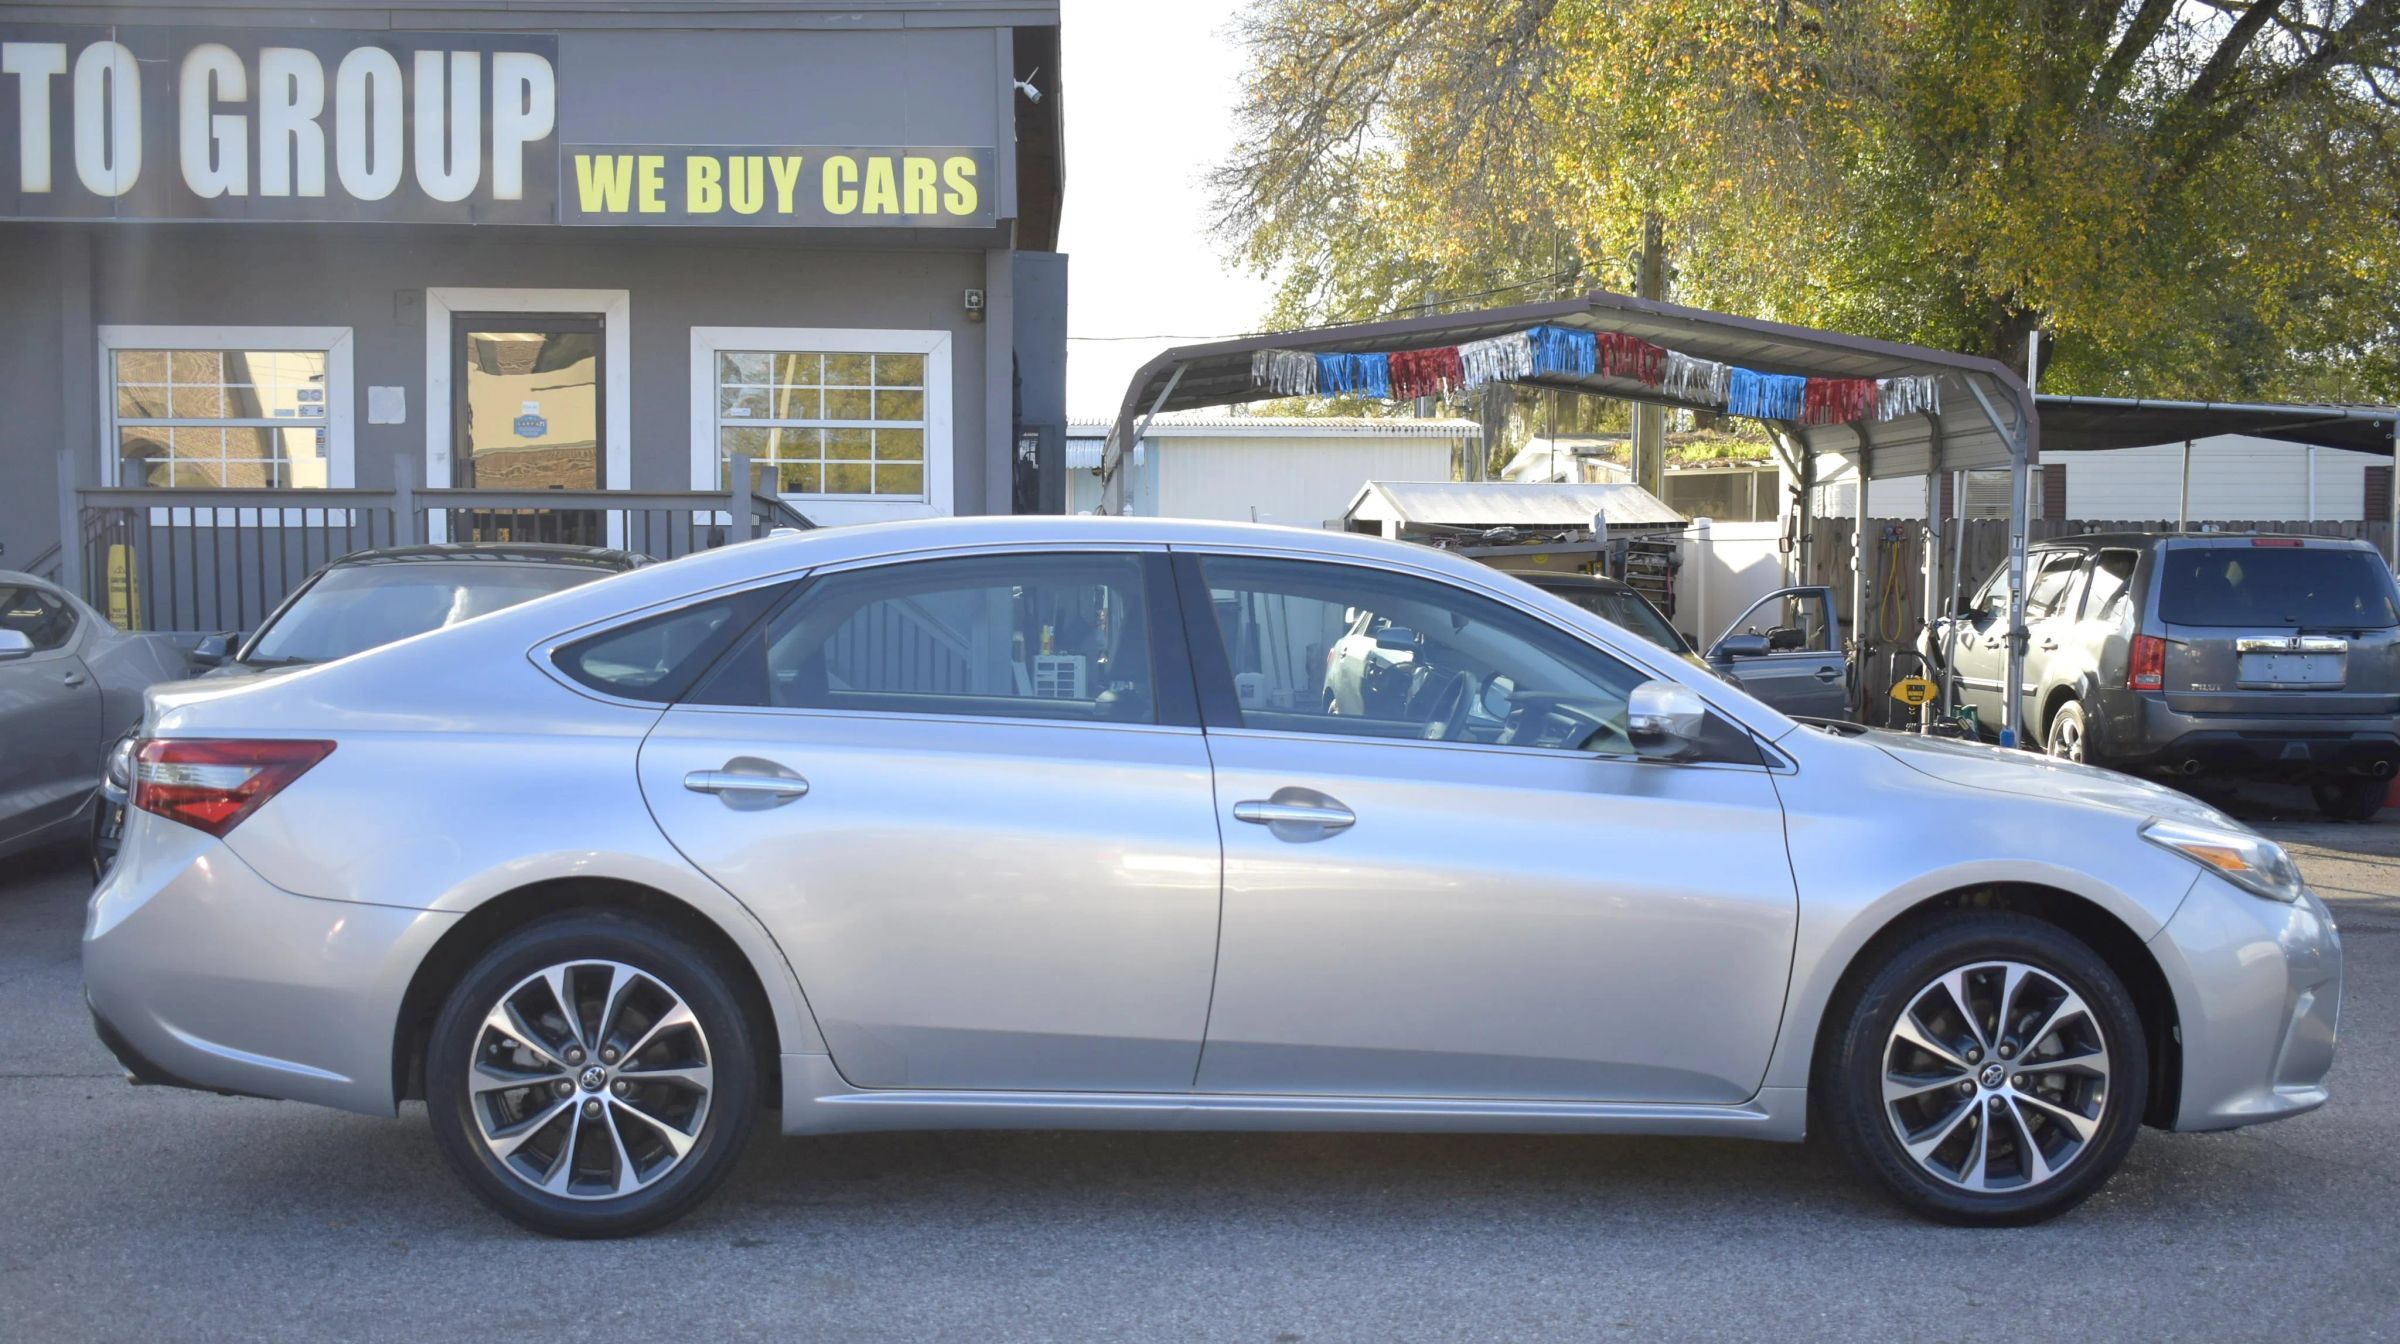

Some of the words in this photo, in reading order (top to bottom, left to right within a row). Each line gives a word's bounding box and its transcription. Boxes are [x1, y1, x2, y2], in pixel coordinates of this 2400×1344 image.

[2, 40, 142, 197] TO
[179, 43, 556, 202] GROUP
[574, 154, 666, 213] WE
[686, 155, 803, 215] BUY
[822, 155, 979, 216] CARS
